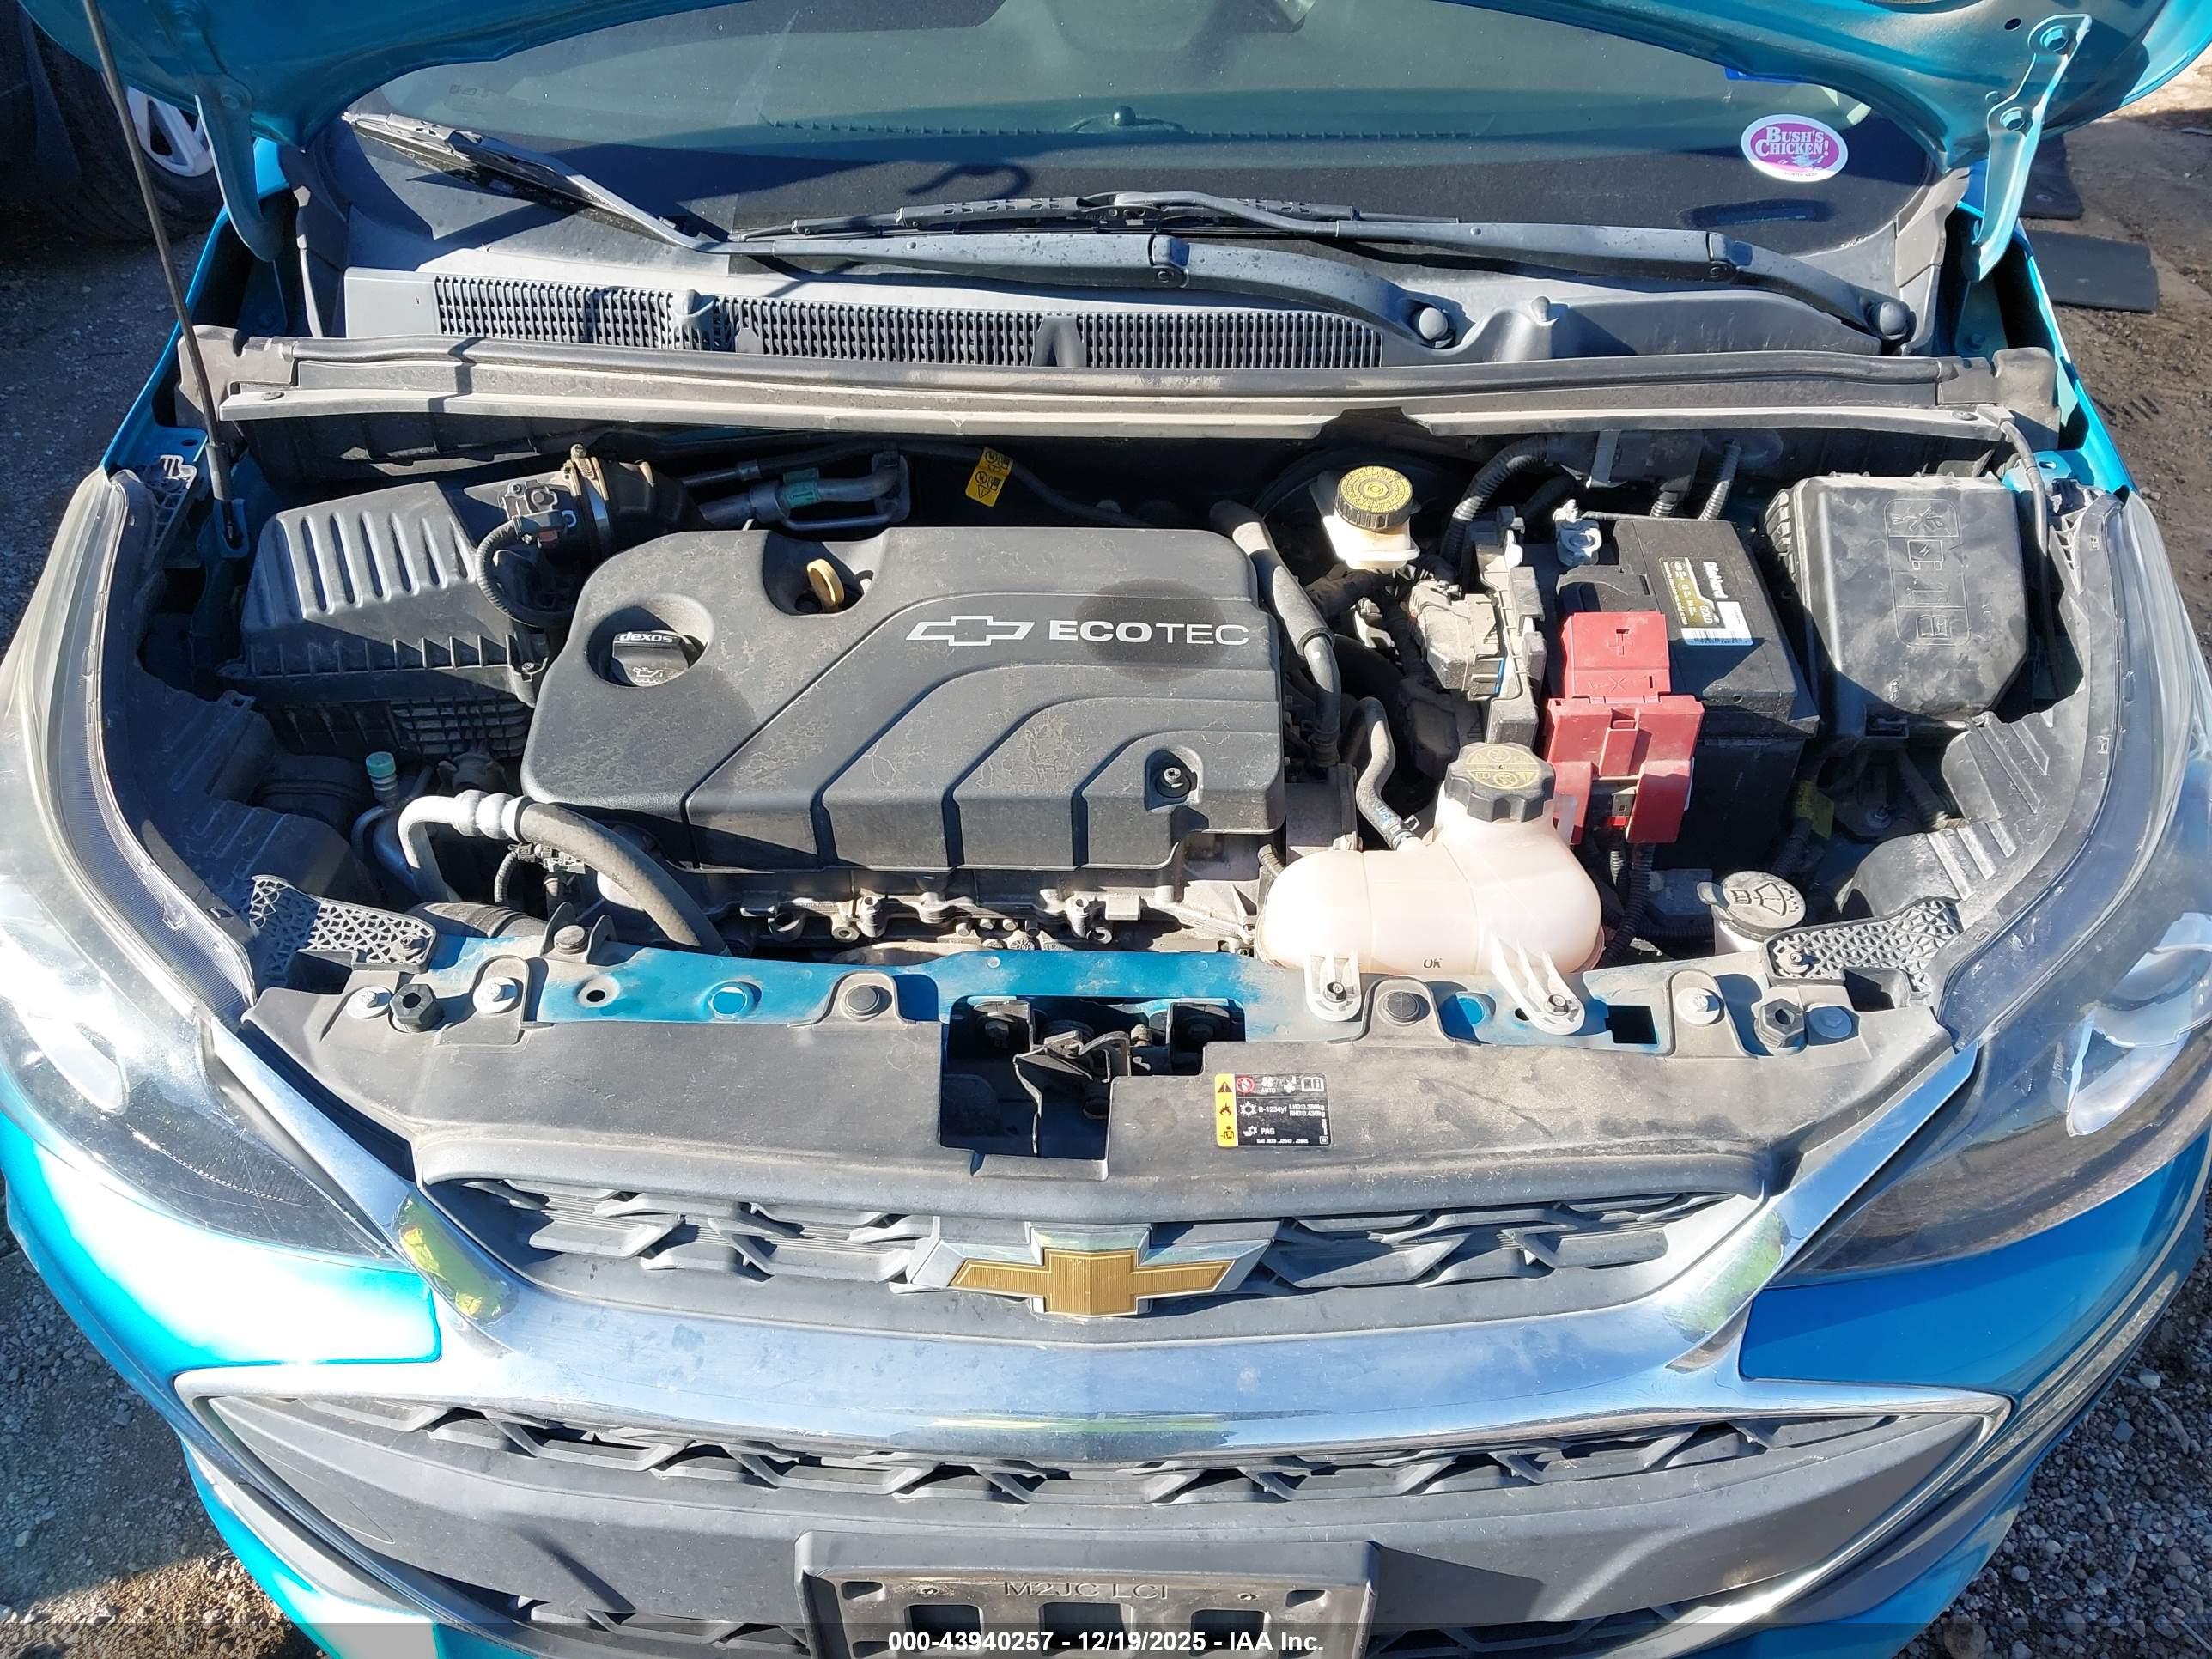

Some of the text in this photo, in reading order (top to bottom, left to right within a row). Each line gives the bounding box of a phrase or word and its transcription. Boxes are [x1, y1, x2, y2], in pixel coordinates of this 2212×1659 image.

[619, 631, 677, 643] dexos
[1048, 619, 1249, 647] ECOTEC
[1003, 1581, 1168, 1600] M2JC LCI
